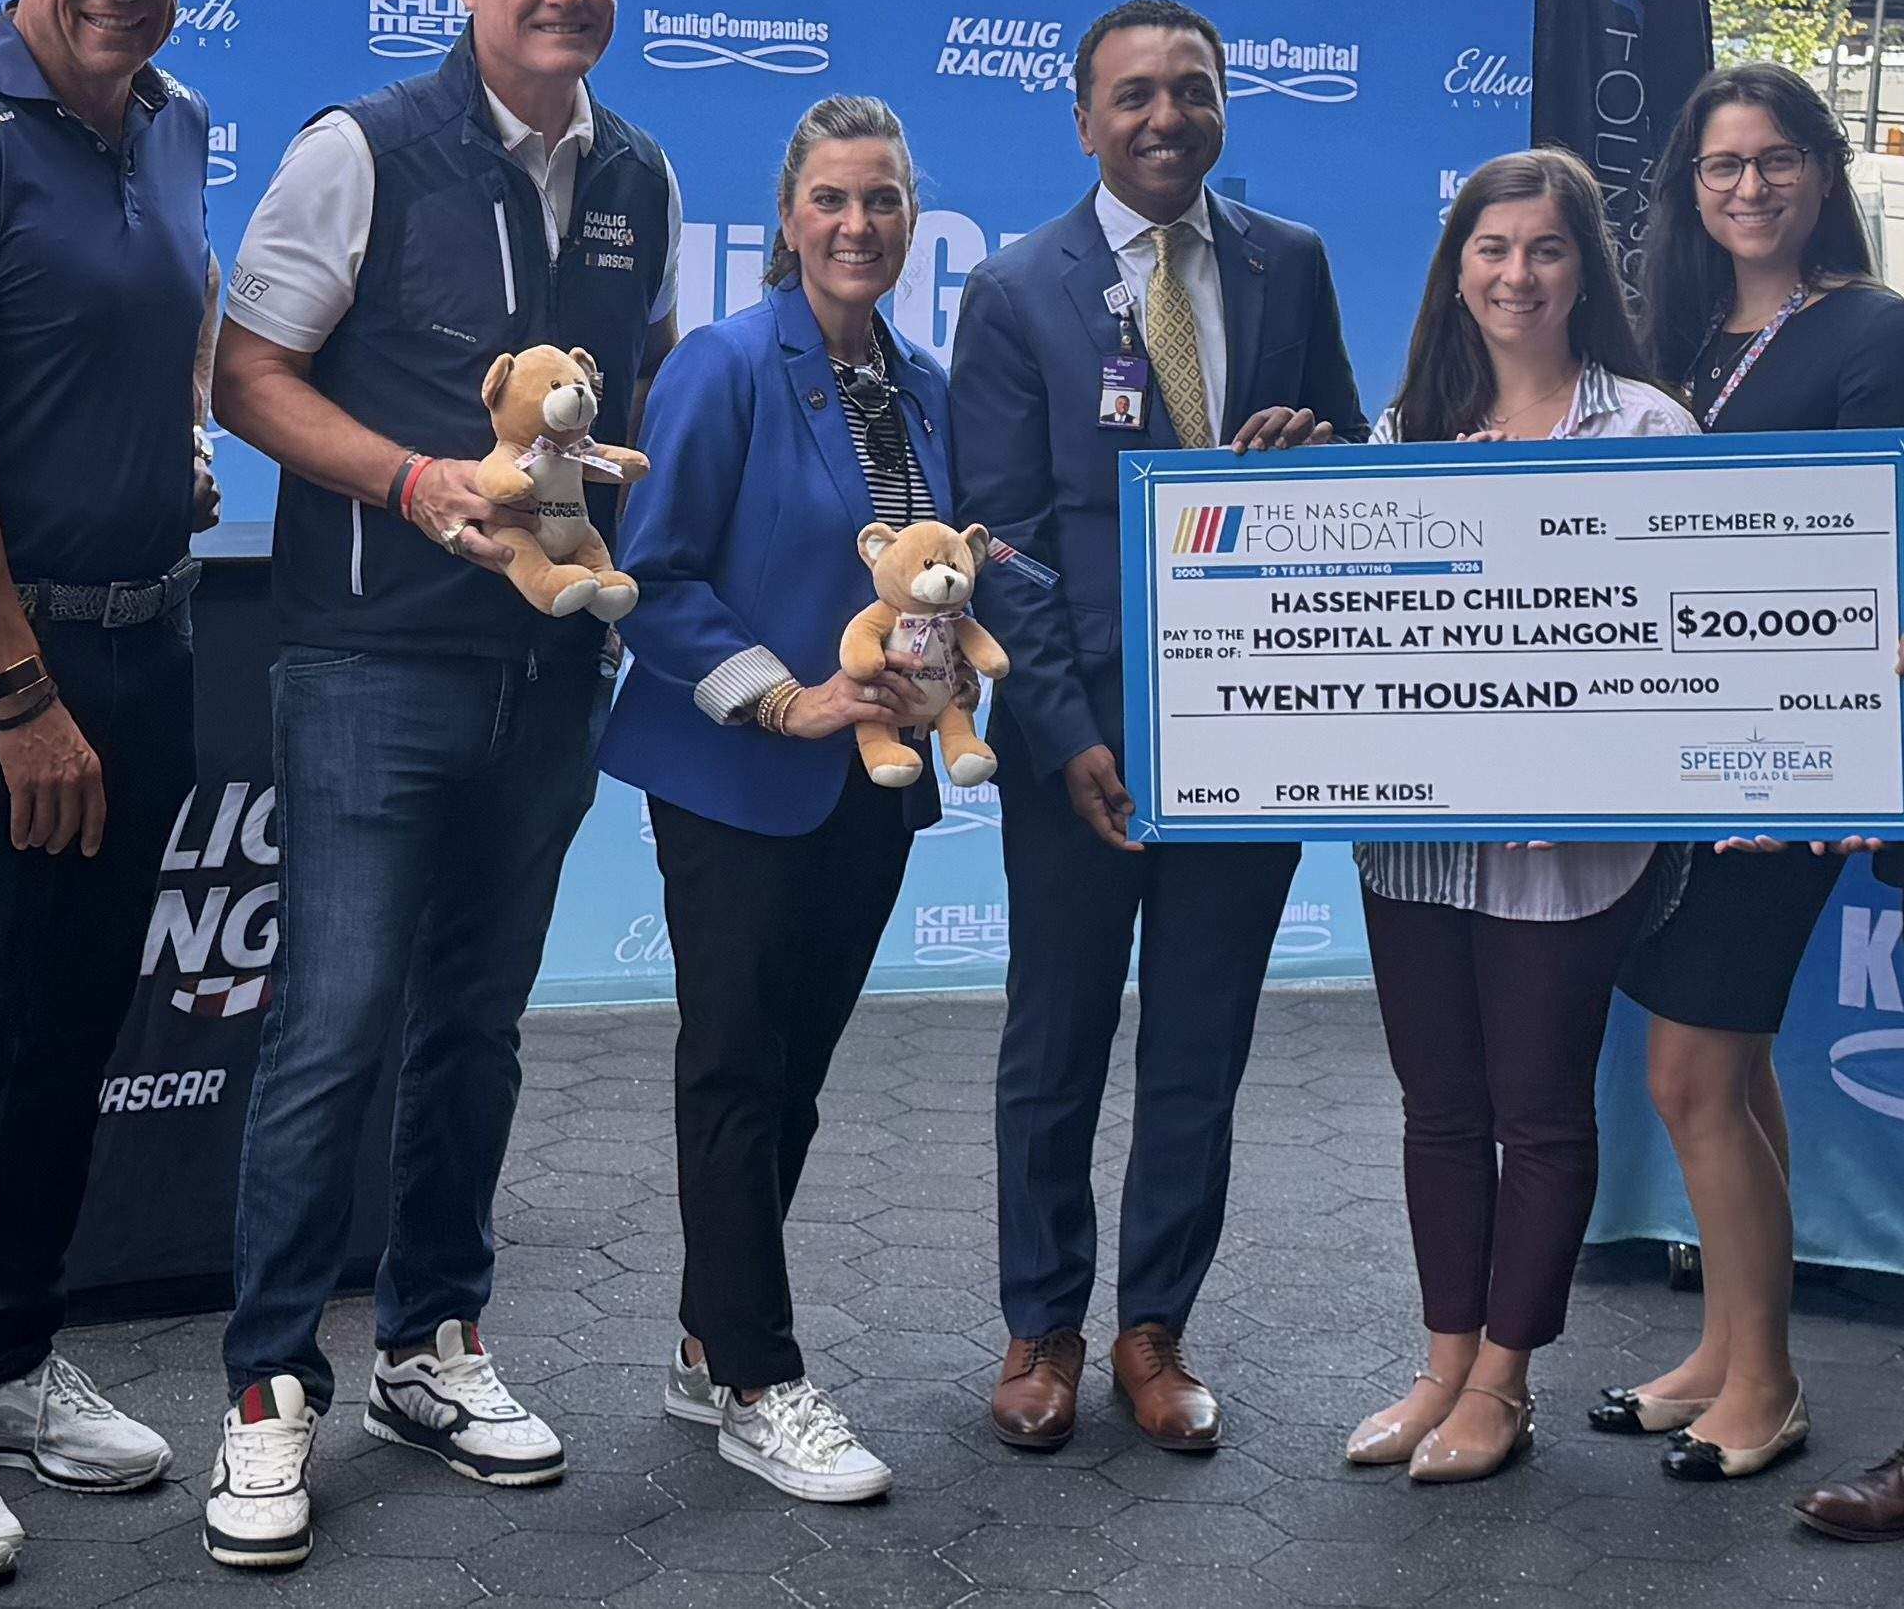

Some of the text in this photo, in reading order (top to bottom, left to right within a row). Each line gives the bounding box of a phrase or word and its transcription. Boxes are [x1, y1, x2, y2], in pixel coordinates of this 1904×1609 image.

[369, 12, 467, 36] MED
[643, 9, 831, 44] KauligCompanies
[945, 16, 1062, 49] KAULIG
[936, 46, 1059, 81] RACING
[1223, 37, 1359, 72] uligCapital
[1444, 47, 1533, 96] Ellsw
[1450, 98, 1520, 111] ADVI
[1253, 501, 1399, 521] THE NASCAR
[1246, 519, 1483, 553] FOUNDATION
[1540, 512, 1854, 536] DATE: SEPTEMBER 9, 2026
[1174, 562, 1480, 578] 2006 20 YEARS OF GIVING 2026
[1271, 585, 1638, 613] HASSENFELD CHILDREN'S
[1163, 628, 1245, 641] PAY TO THE
[1253, 622, 1659, 650] HOSPITAL AT NYU LANGONE
[1163, 647, 1242, 659] ORDER OF:
[1217, 677, 1882, 711] TWENTY THOUSAND AND 00/100 DOLLARS
[1680, 751, 1833, 770] SPEEDY BEAR
[1724, 771, 1789, 781] BRIGADE
[1177, 783, 1434, 804] MEMO FOR THE KIDS!
